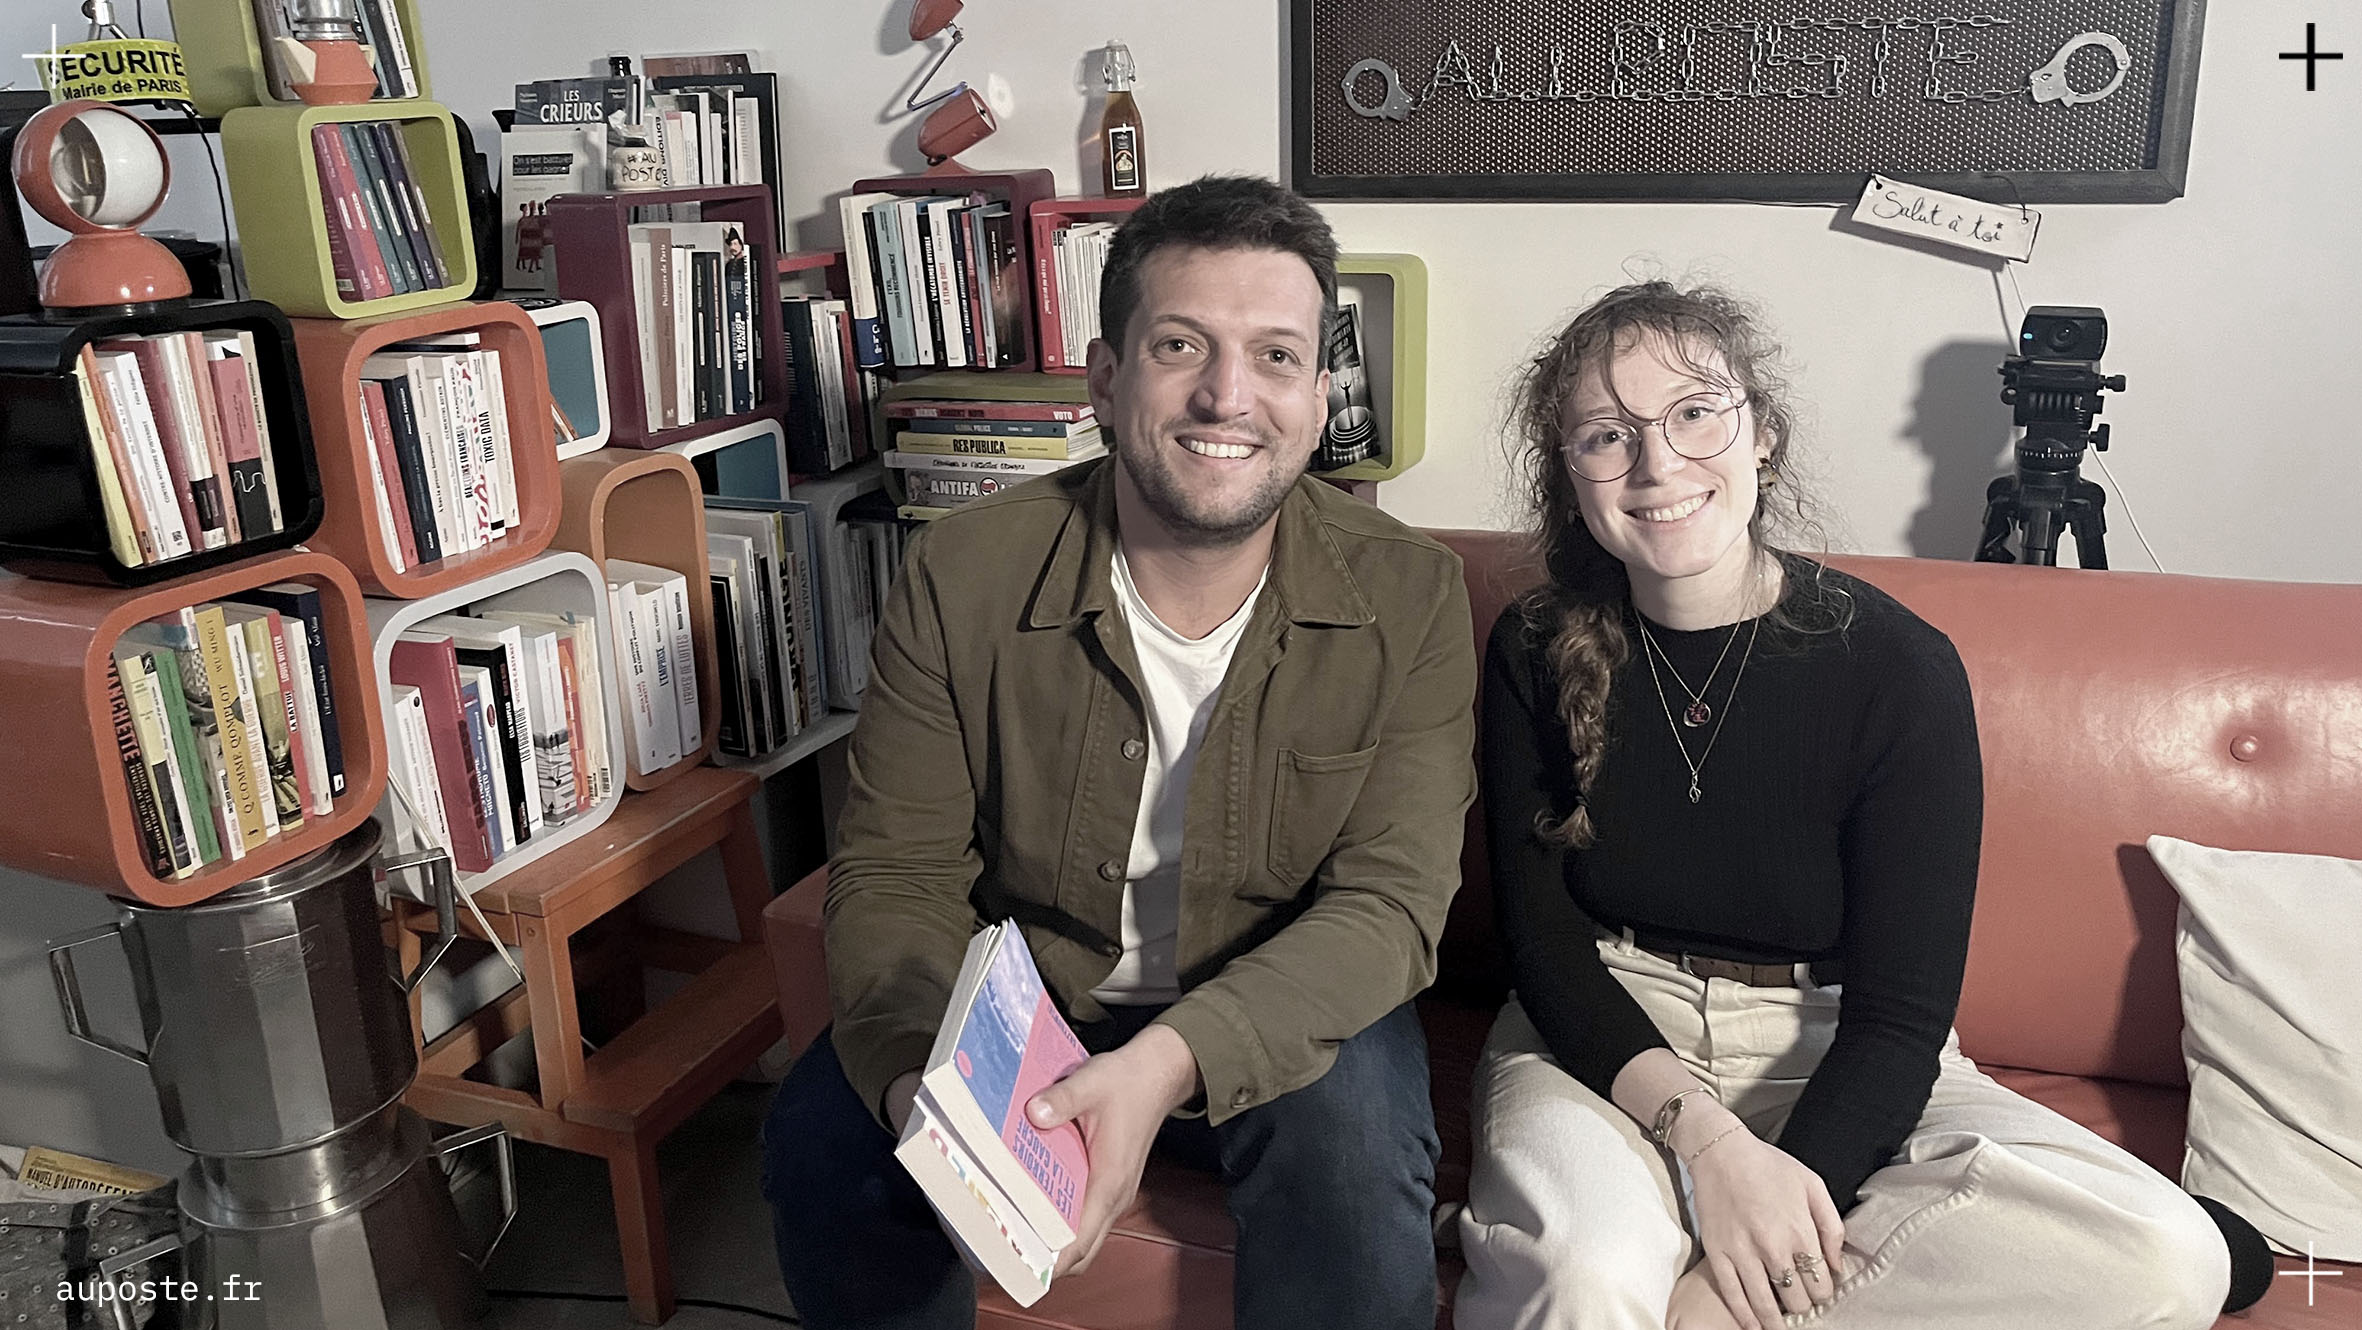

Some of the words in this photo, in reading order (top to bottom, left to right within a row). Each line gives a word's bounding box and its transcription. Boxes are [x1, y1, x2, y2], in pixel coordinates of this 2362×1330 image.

[48, 47, 186, 85] SÉCURITÉ
[62, 83, 106, 100] Mairie
[112, 80, 132, 94] de
[137, 78, 182, 92] PARIS
[564, 90, 580, 102] LES
[540, 102, 604, 123] CRIEURS
[513, 156, 524, 165] On
[642, 153, 657, 164] AU
[1873, 191, 1943, 226] Salut
[1949, 215, 1962, 232] à
[1967, 215, 2004, 242] toi
[923, 235, 933, 263] INVISIBLE
[660, 264, 666, 273] de
[937, 261, 947, 279] DROIT
[926, 264, 938, 301] L'HÉCATOMBE
[940, 280, 949, 296] TENIR
[961, 298, 970, 326] RÉVOLUTION
[734, 311, 742, 350] POLICES
[741, 351, 746, 361] EN
[477, 411, 491, 434] DATA
[1052, 411, 1073, 421] VOTO
[481, 435, 495, 463] TOXIC
[953, 439, 969, 454] RES
[970, 440, 1006, 454] PUBLICA
[930, 480, 979, 496] ANTIFA
[797, 559, 810, 607] VIVANTS
[207, 627, 218, 653] MING
[272, 635, 286, 662] WITTER
[675, 634, 691, 662] LUTTES
[213, 656, 223, 673] WU
[508, 642, 517, 676] CASTANET
[680, 664, 691, 674] DE
[277, 661, 290, 682] LOUIS
[512, 678, 521, 703] VICTOR
[680, 676, 696, 705] TERRES
[108, 652, 139, 761] MANCHETTE
[217, 682, 242, 748] QOMPLOT
[290, 721, 297, 732] LA
[232, 751, 250, 800] COMME
[242, 801, 255, 814] Q
[1015, 1115, 1049, 1167] GAUCHE
[1011, 1133, 1054, 1195] TERROIRS
[1052, 1159, 1065, 1182] LA
[26, 1168, 53, 1186] MANUEL
[1062, 1176, 1076, 1200] ET
[1055, 1188, 1071, 1219] LES
